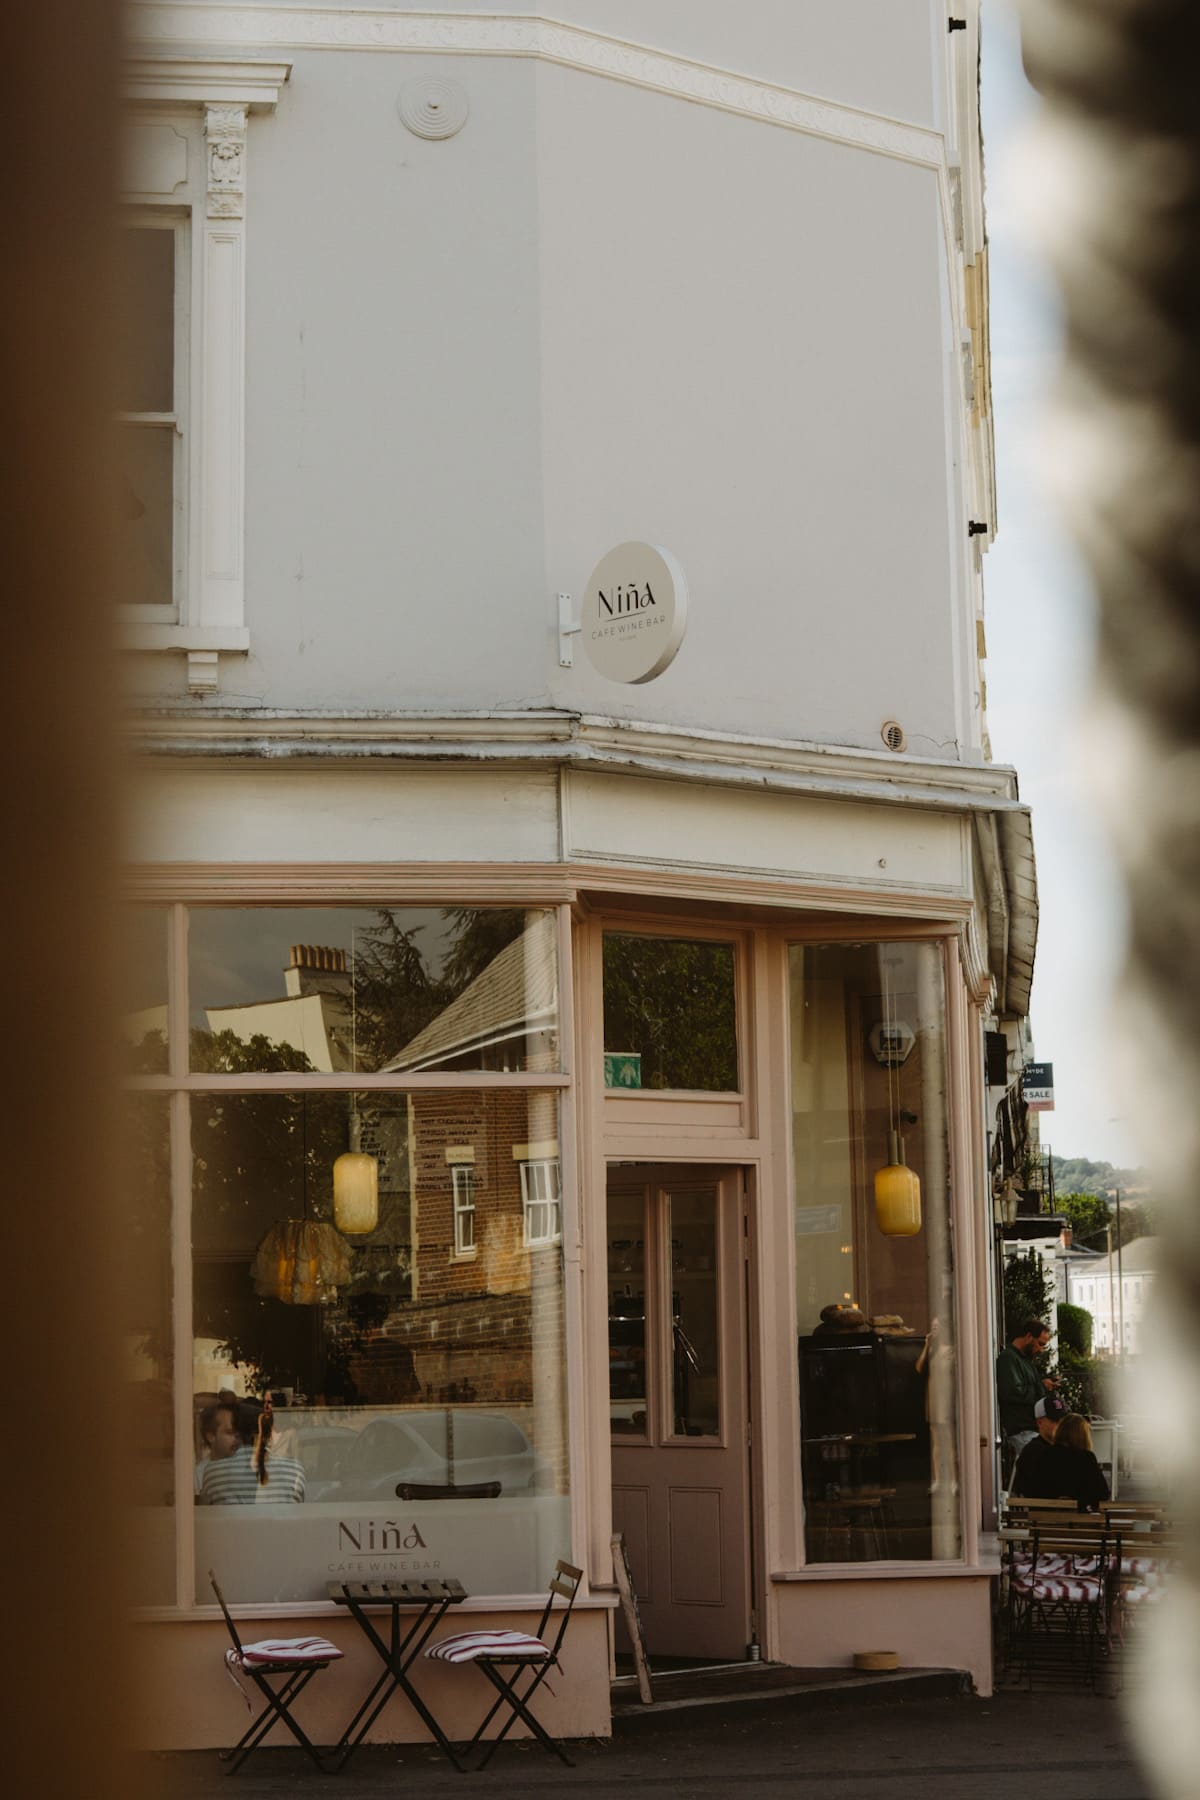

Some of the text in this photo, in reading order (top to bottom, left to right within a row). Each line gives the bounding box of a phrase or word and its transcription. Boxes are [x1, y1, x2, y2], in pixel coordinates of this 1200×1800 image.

[592, 627, 616, 641] CAFE
[618, 620, 644, 633] WINE
[646, 615, 666, 628] BAR
[327, 1560, 441, 1572] CAFE WINE BAR
